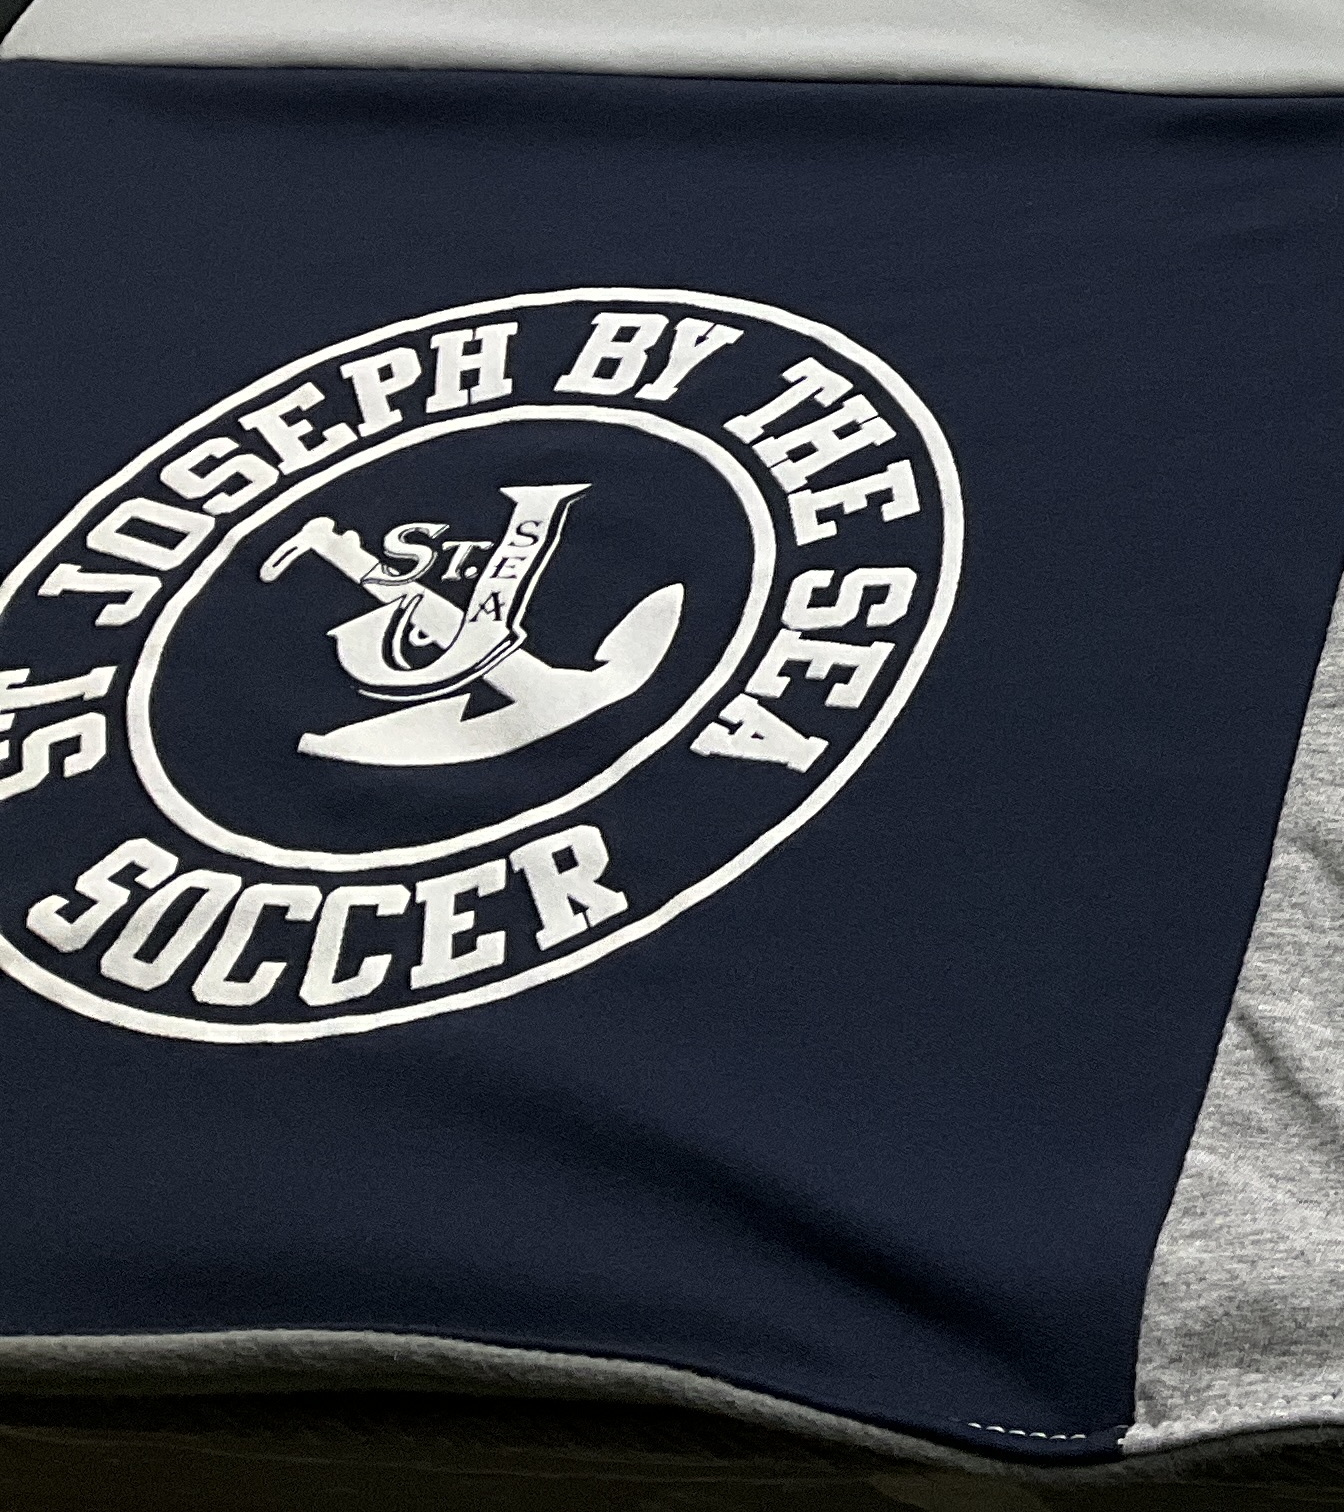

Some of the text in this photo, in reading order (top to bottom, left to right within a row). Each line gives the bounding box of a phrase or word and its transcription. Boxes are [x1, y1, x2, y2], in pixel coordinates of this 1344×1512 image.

[554, 311, 744, 402] BY
[721, 356, 923, 547] THE
[38, 321, 519, 628] JOSEPH
[688, 565, 919, 776] SEA
[26, 823, 628, 1008] SOCCER
